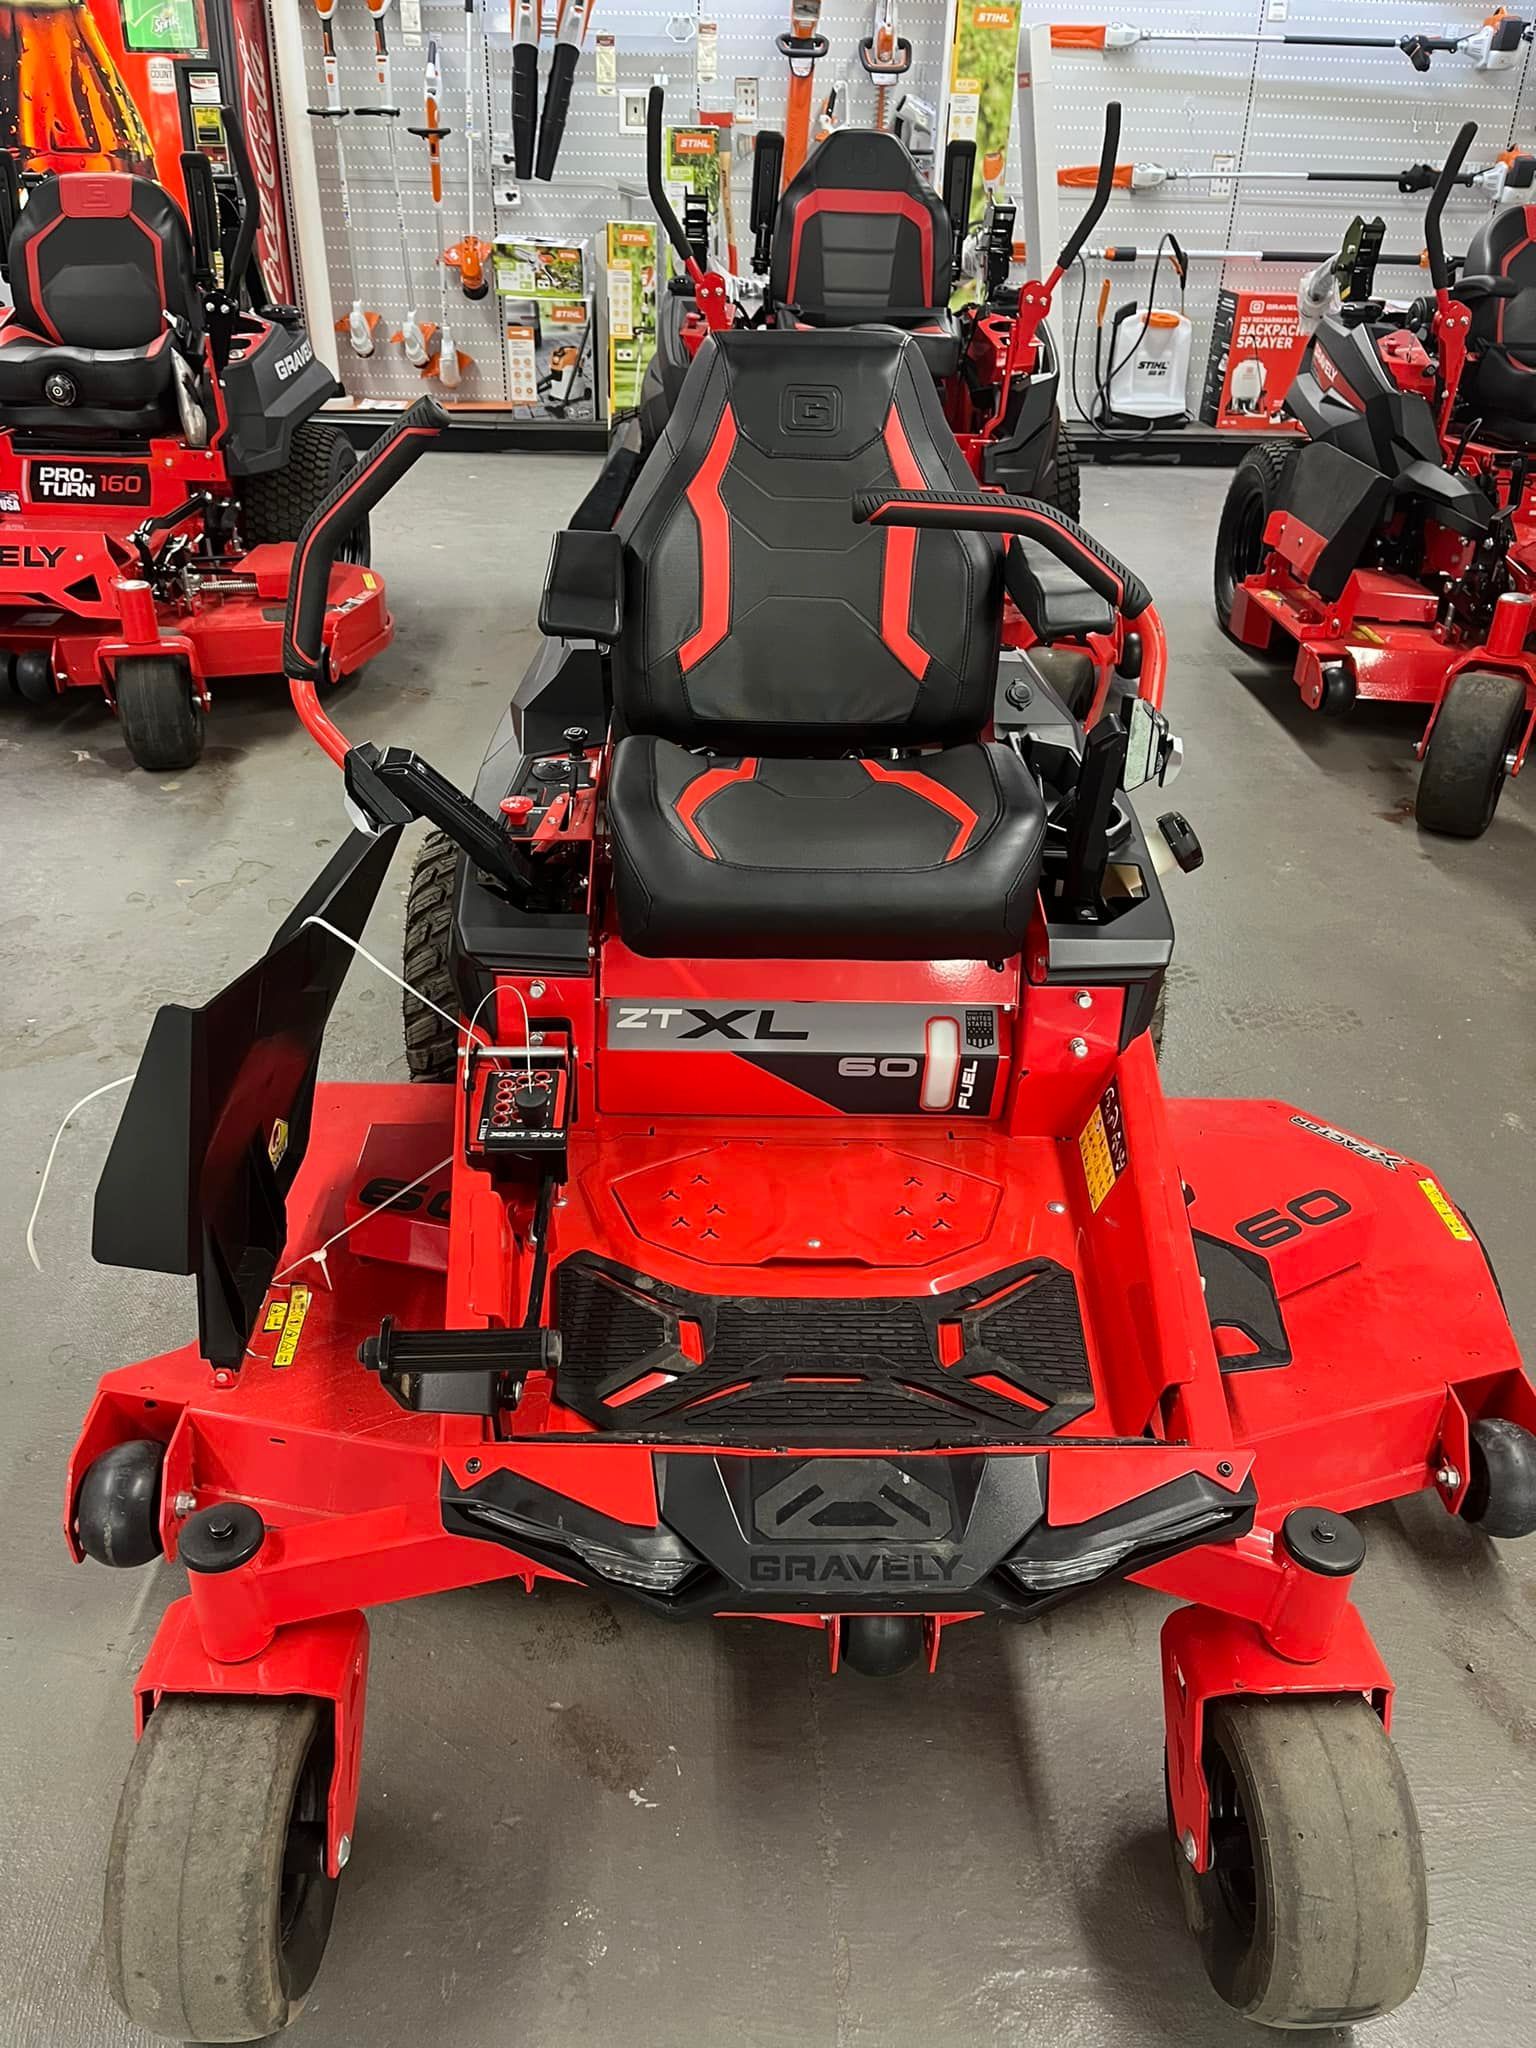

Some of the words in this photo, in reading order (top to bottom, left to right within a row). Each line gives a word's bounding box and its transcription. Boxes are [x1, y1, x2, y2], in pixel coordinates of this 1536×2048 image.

[978, 12, 1010, 24] STIHL
[151, 70, 173, 80] COUNT
[680, 138, 711, 149] STIHL
[621, 233, 648, 243] STIHL
[555, 309, 582, 319] STIHL
[1236, 336, 1293, 349] SPRAYER
[1137, 361, 1168, 370] STIHL
[39, 466, 93, 483] PRO-
[39, 481, 95, 497] TURN
[100, 475, 141, 494] 160
[0, 499, 21, 512] USA
[616, 1007, 683, 1029] ZT
[676, 1008, 809, 1040] XL
[838, 1057, 918, 1078] 60
[958, 1060, 979, 1110] FUEL
[1235, 1190, 1352, 1248] 60
[750, 1555, 962, 1582] GRAVELY
